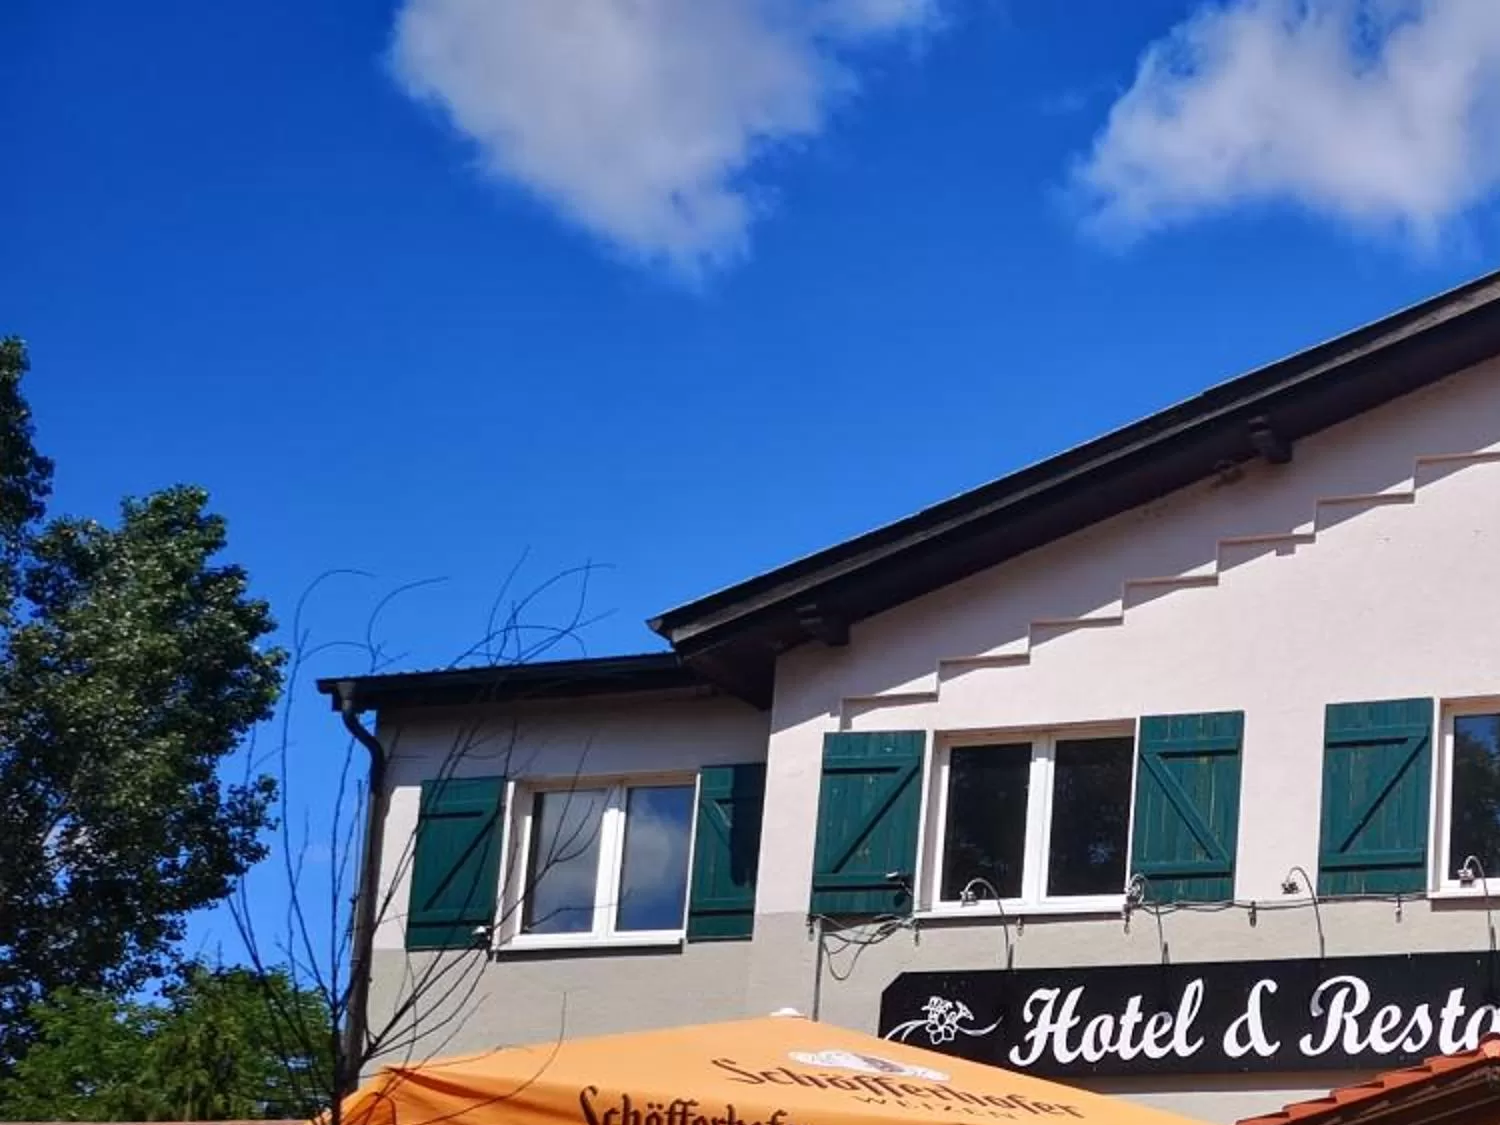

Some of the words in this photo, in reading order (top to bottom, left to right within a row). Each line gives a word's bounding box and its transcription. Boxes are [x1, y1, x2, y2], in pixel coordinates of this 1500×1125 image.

[1009, 978, 1204, 1065] Hotel
[1222, 979, 1281, 1058] &
[711, 1056, 1087, 1120] Schöfferhofer
